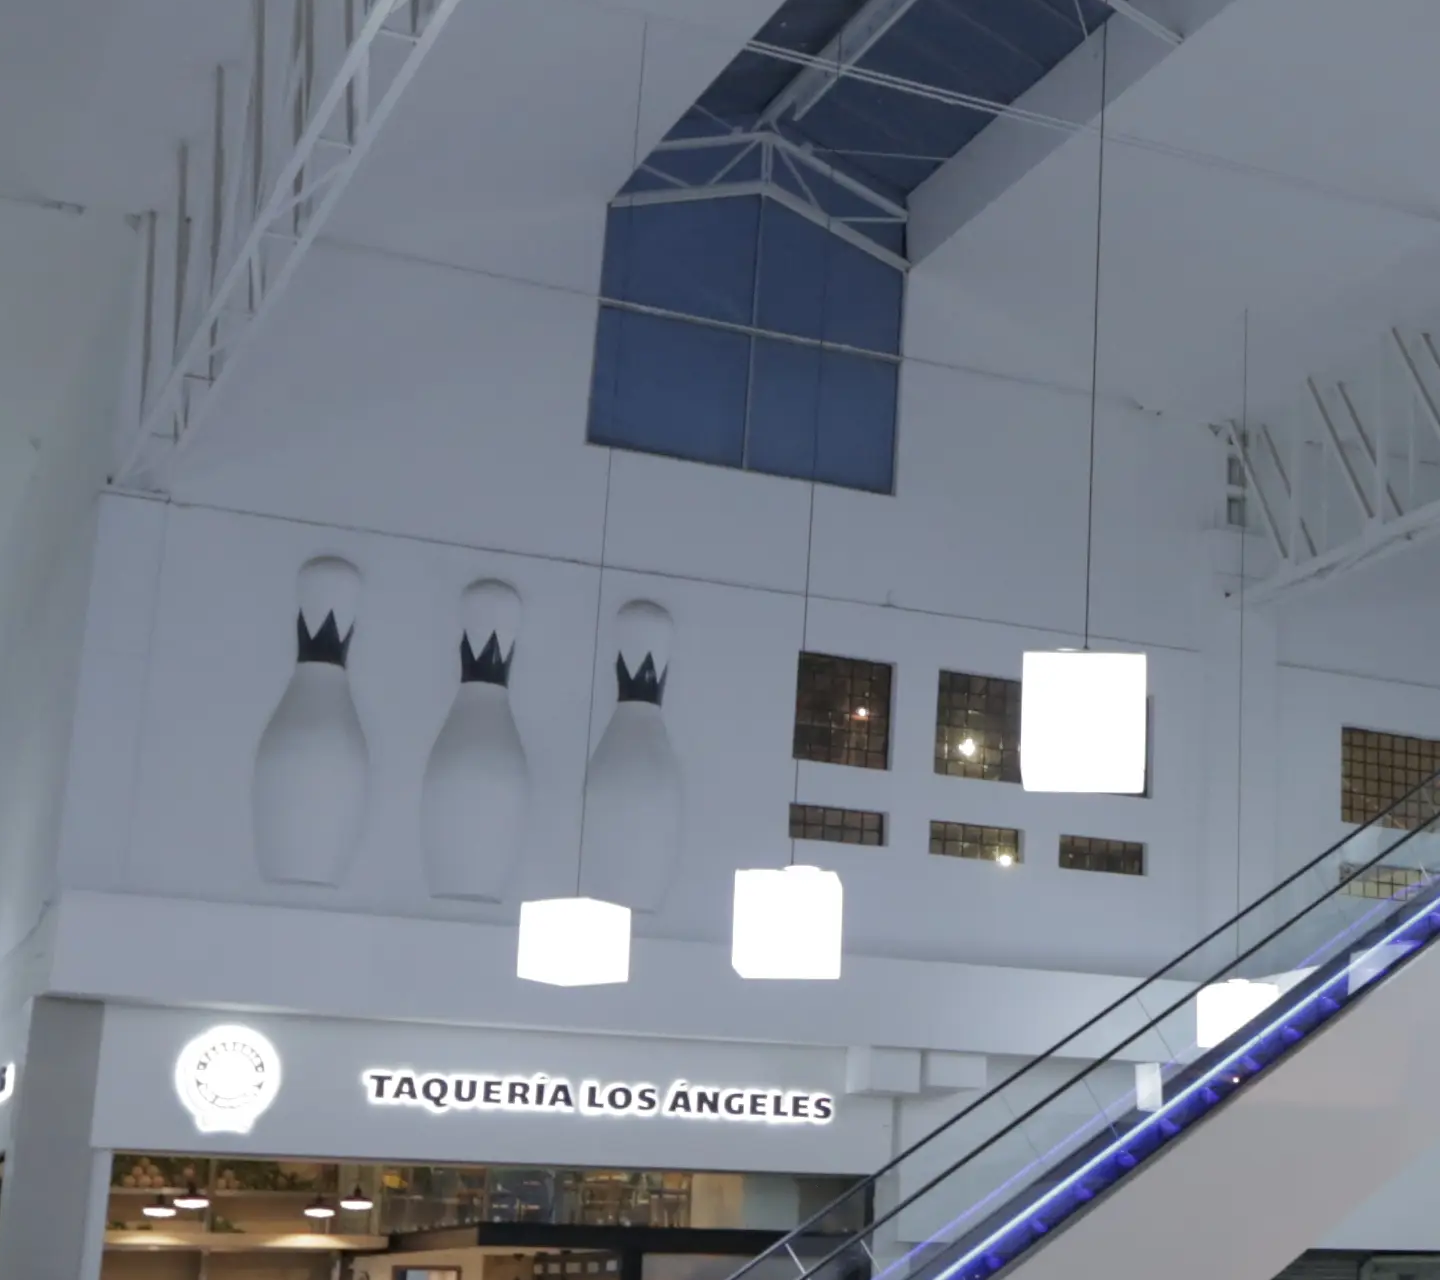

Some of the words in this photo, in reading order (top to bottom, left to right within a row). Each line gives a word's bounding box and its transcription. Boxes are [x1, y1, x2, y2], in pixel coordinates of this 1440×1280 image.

[369, 1073, 574, 1108] TAQUERÍA
[587, 1086, 656, 1111] LOS
[669, 1082, 833, 1120] ÁNGELES
